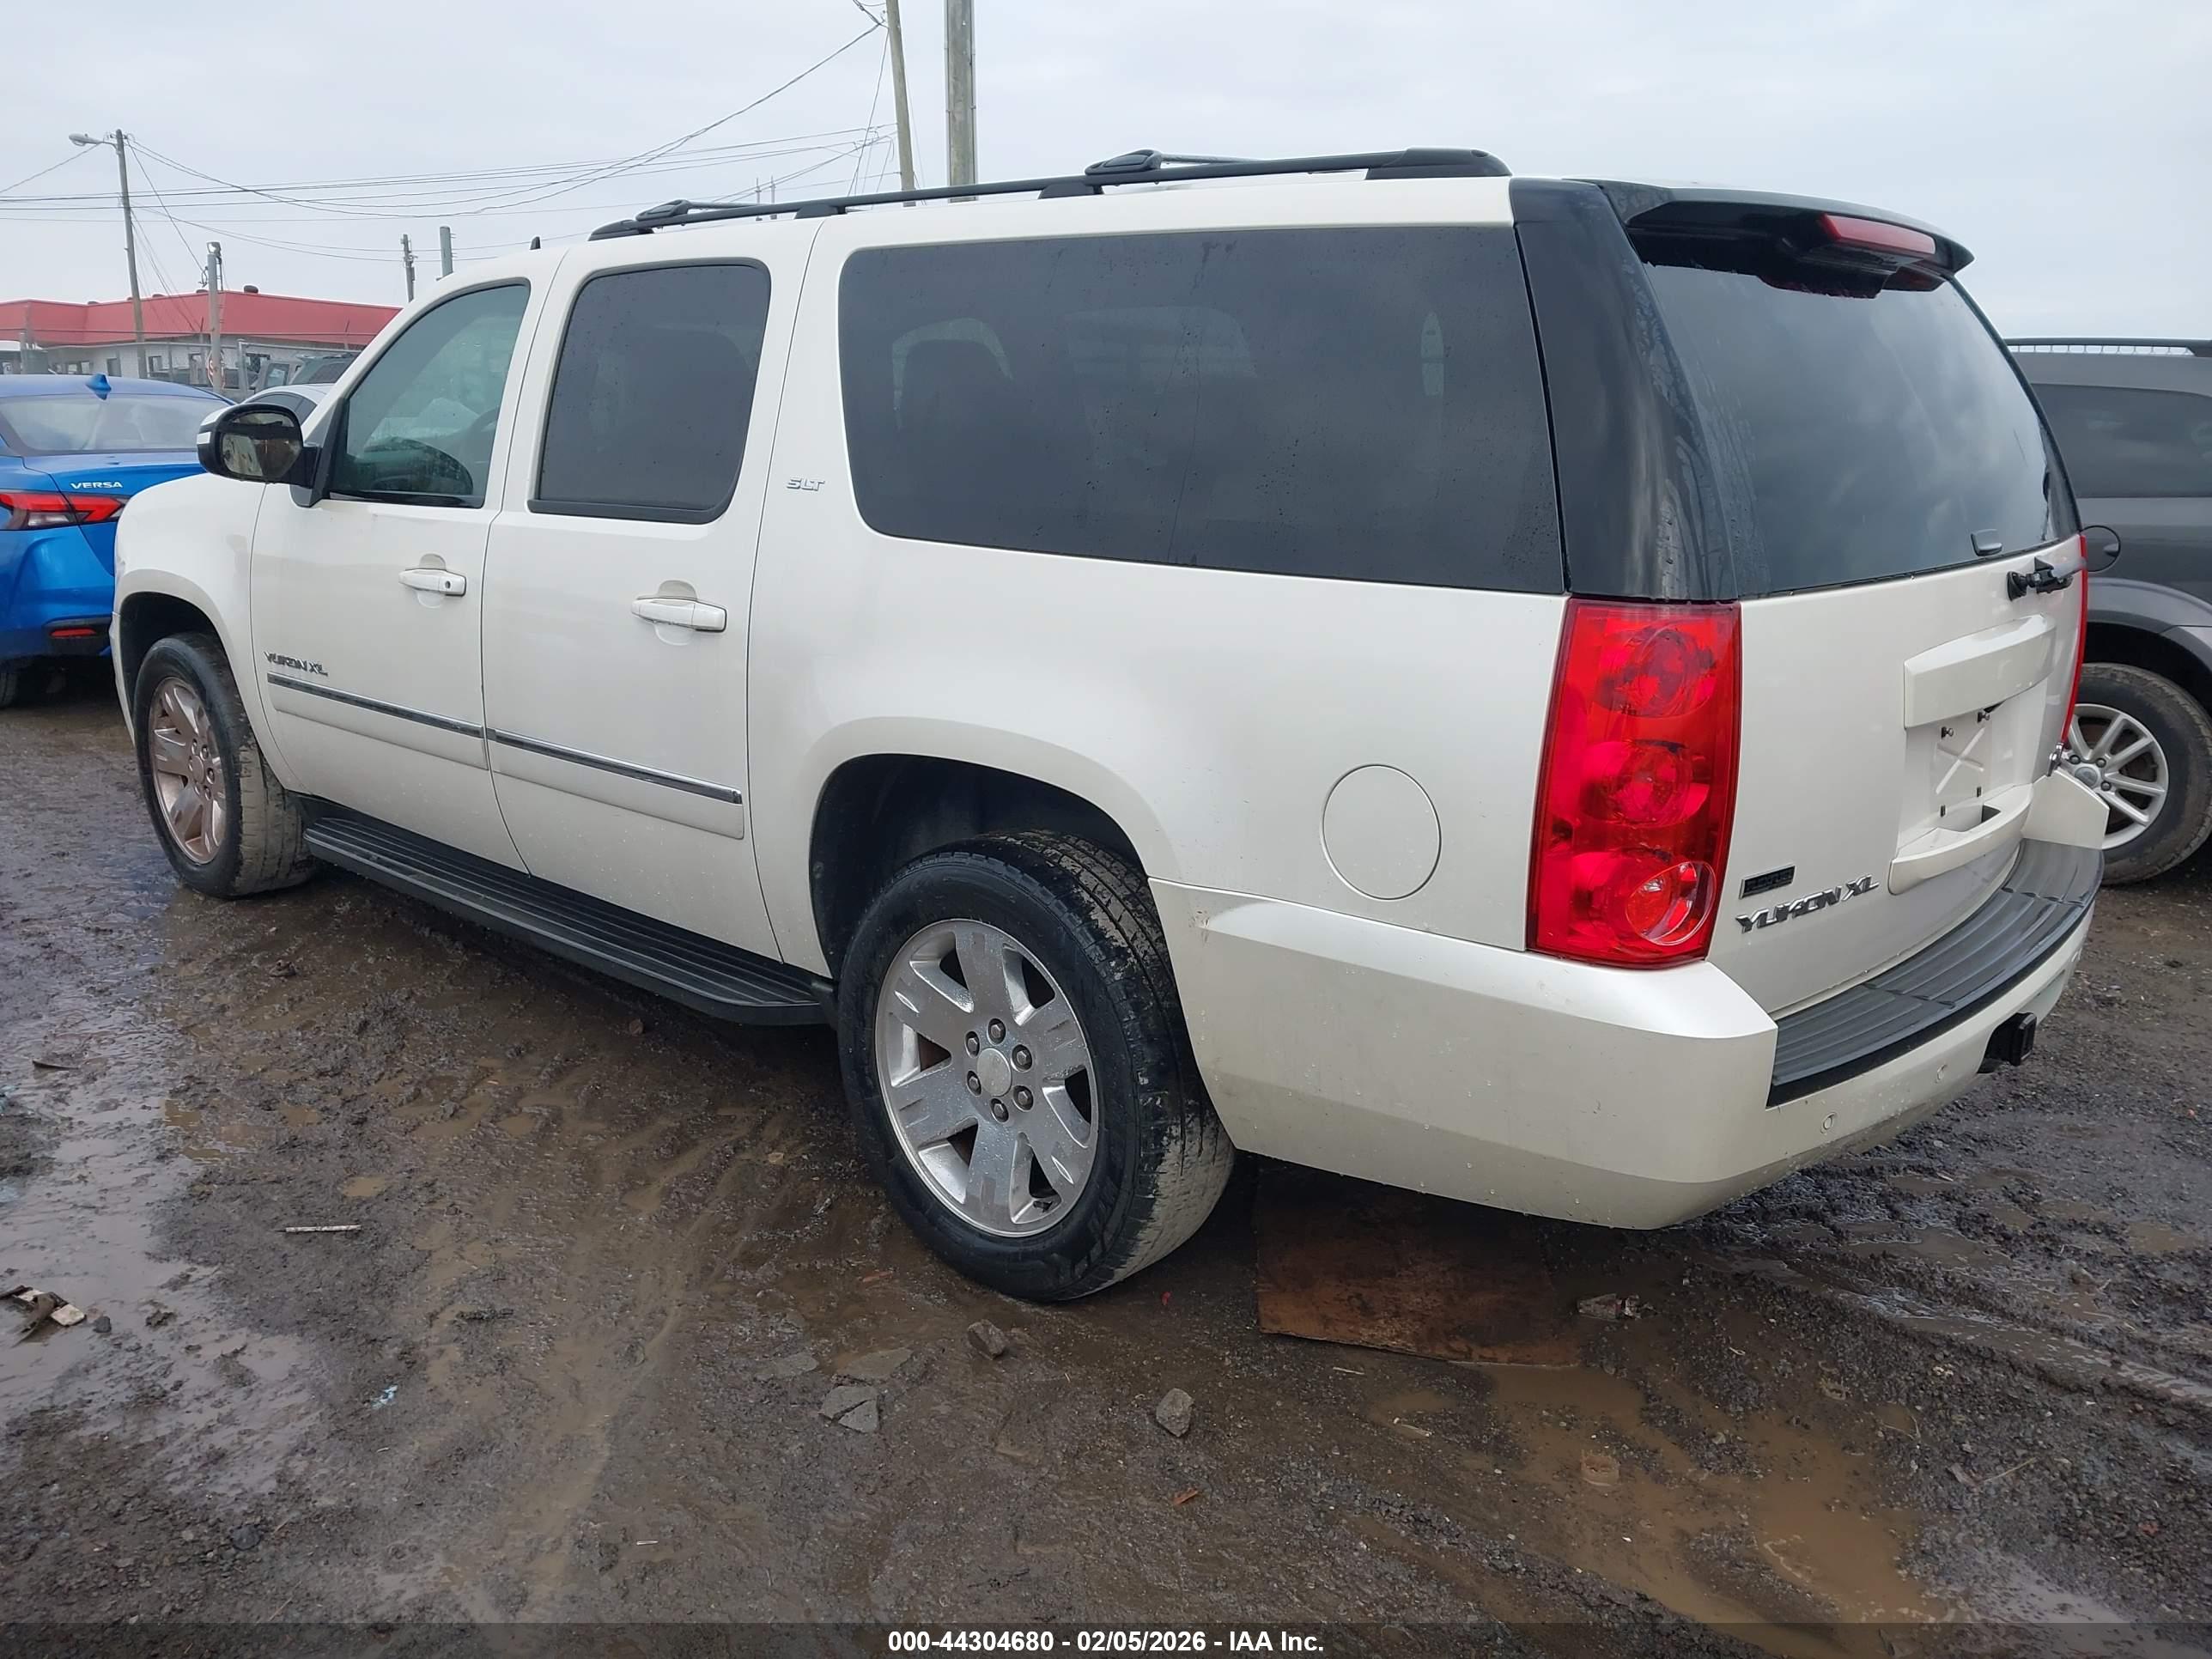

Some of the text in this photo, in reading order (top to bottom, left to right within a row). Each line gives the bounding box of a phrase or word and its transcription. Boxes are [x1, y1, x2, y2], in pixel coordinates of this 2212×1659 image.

[70, 481, 124, 490] VERSA
[786, 477, 825, 492] SLT
[309, 661, 328, 677] XL
[1735, 874, 1880, 934] YUKON XL
